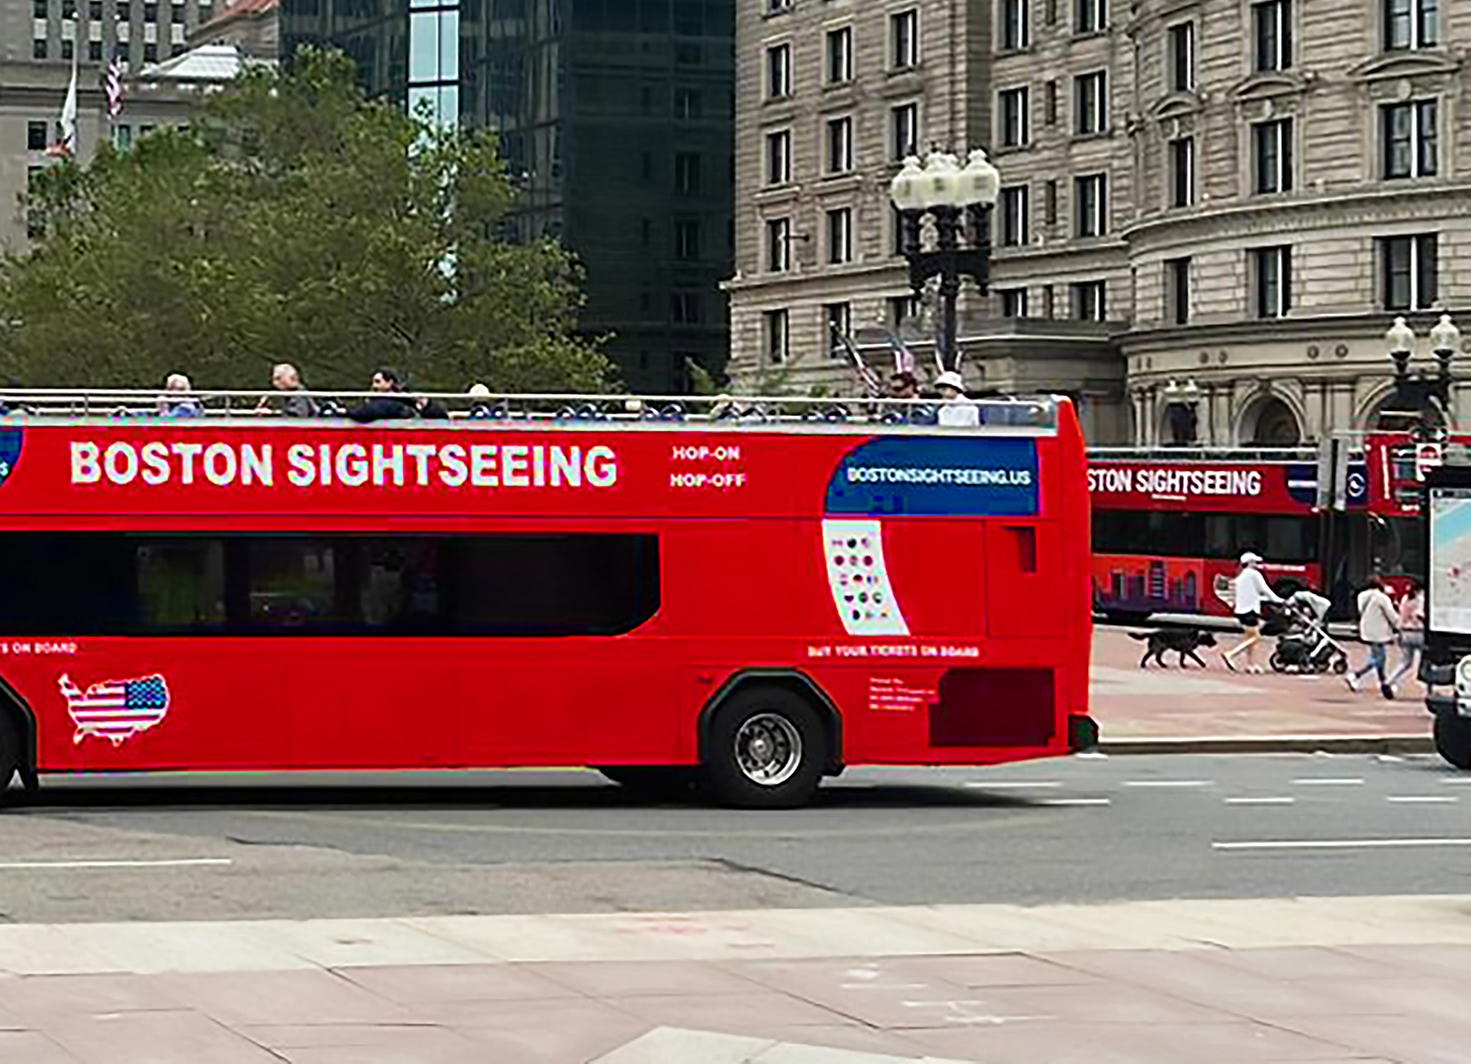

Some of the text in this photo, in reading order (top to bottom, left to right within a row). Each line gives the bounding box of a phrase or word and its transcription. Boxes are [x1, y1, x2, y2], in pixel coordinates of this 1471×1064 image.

[672, 445, 740, 461] HOP-ON
[70, 441, 618, 487] BOSTON SIGHTSEEING
[670, 473, 747, 487] HOP-OFF
[847, 467, 1031, 485] BOSTONSIGHTSEEING.US
[1136, 469, 1262, 495] SIGHTSEEING
[12, 643, 31, 654] ON
[34, 642, 77, 655] BOARD
[807, 645, 831, 657] BUY
[834, 645, 869, 657] YOUR
[940, 645, 979, 657] BOARD
